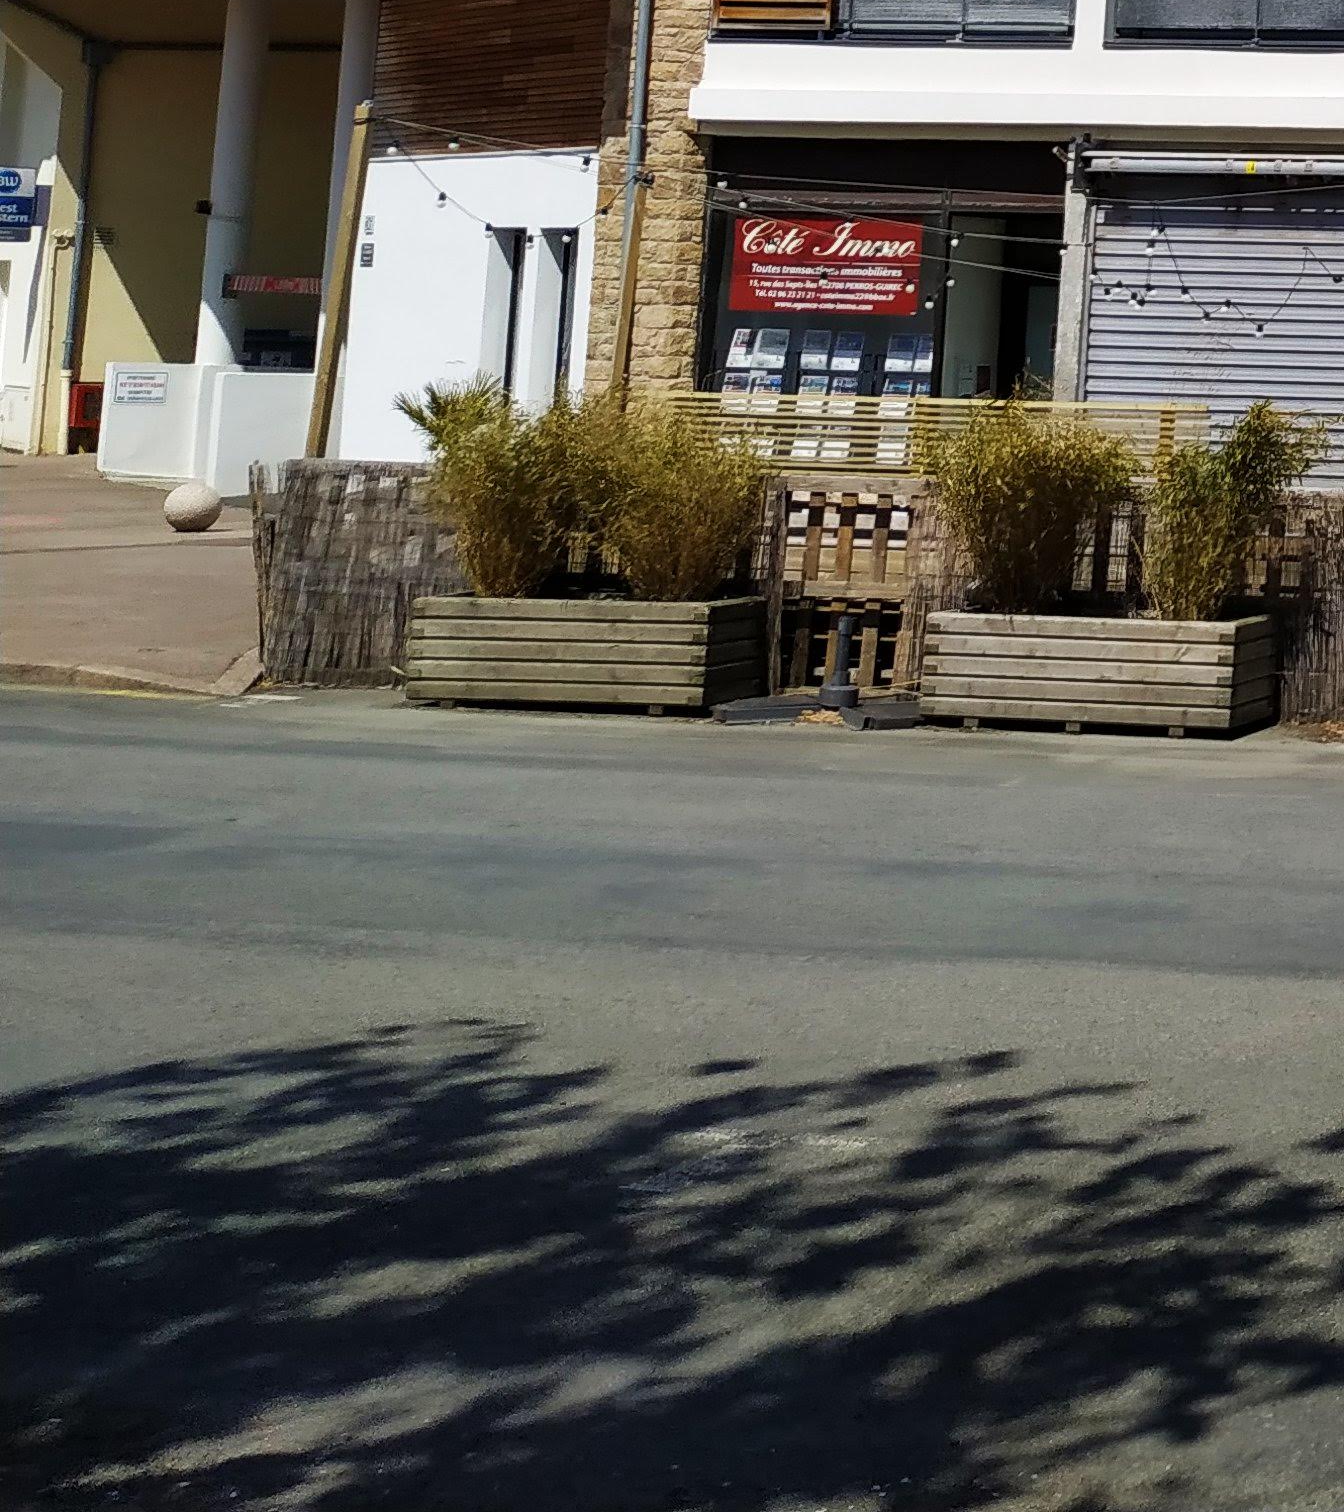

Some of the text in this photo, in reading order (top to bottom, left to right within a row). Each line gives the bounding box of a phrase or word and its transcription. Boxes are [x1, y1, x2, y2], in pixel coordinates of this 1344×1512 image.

[0, 203, 18, 213] est
[751, 262, 781, 274] Toutes
[840, 266, 903, 277] immobilières
